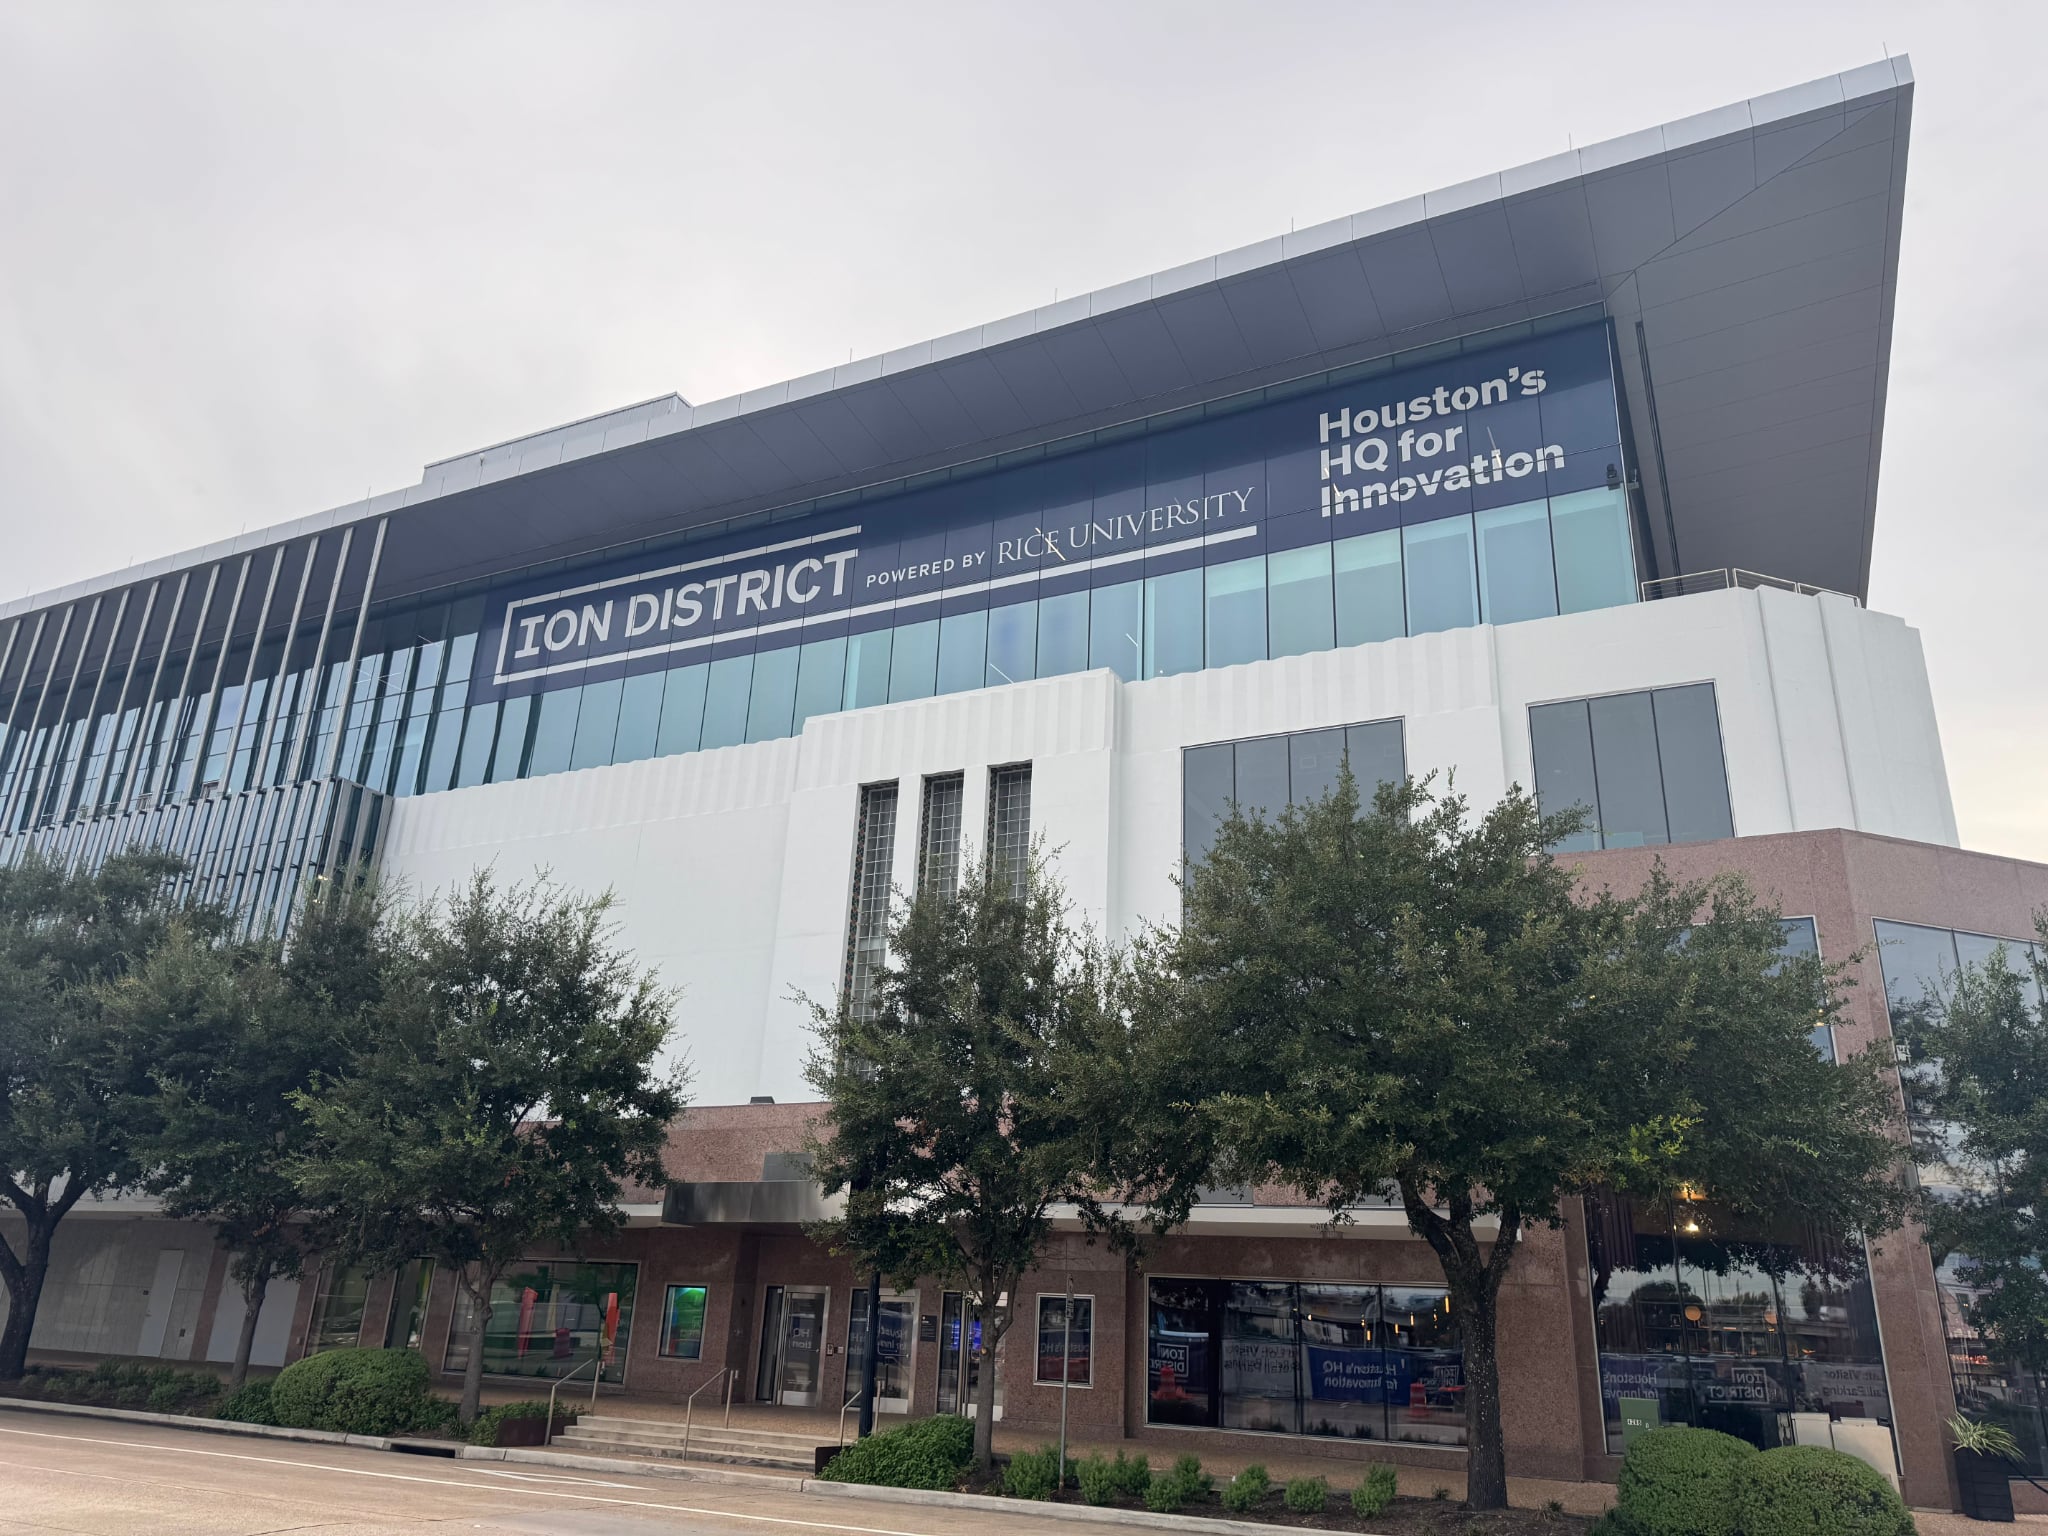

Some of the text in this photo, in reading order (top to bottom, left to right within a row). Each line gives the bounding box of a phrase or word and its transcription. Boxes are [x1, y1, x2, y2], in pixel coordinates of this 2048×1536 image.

[1319, 366, 1548, 443] Houston’s
[1320, 425, 1463, 481] HQ for
[1321, 443, 1565, 518] Innovation
[997, 486, 1256, 566] RICE UNIVERSITY
[514, 548, 859, 659] ION DISTRICT
[866, 550, 986, 588] POWERED BY
